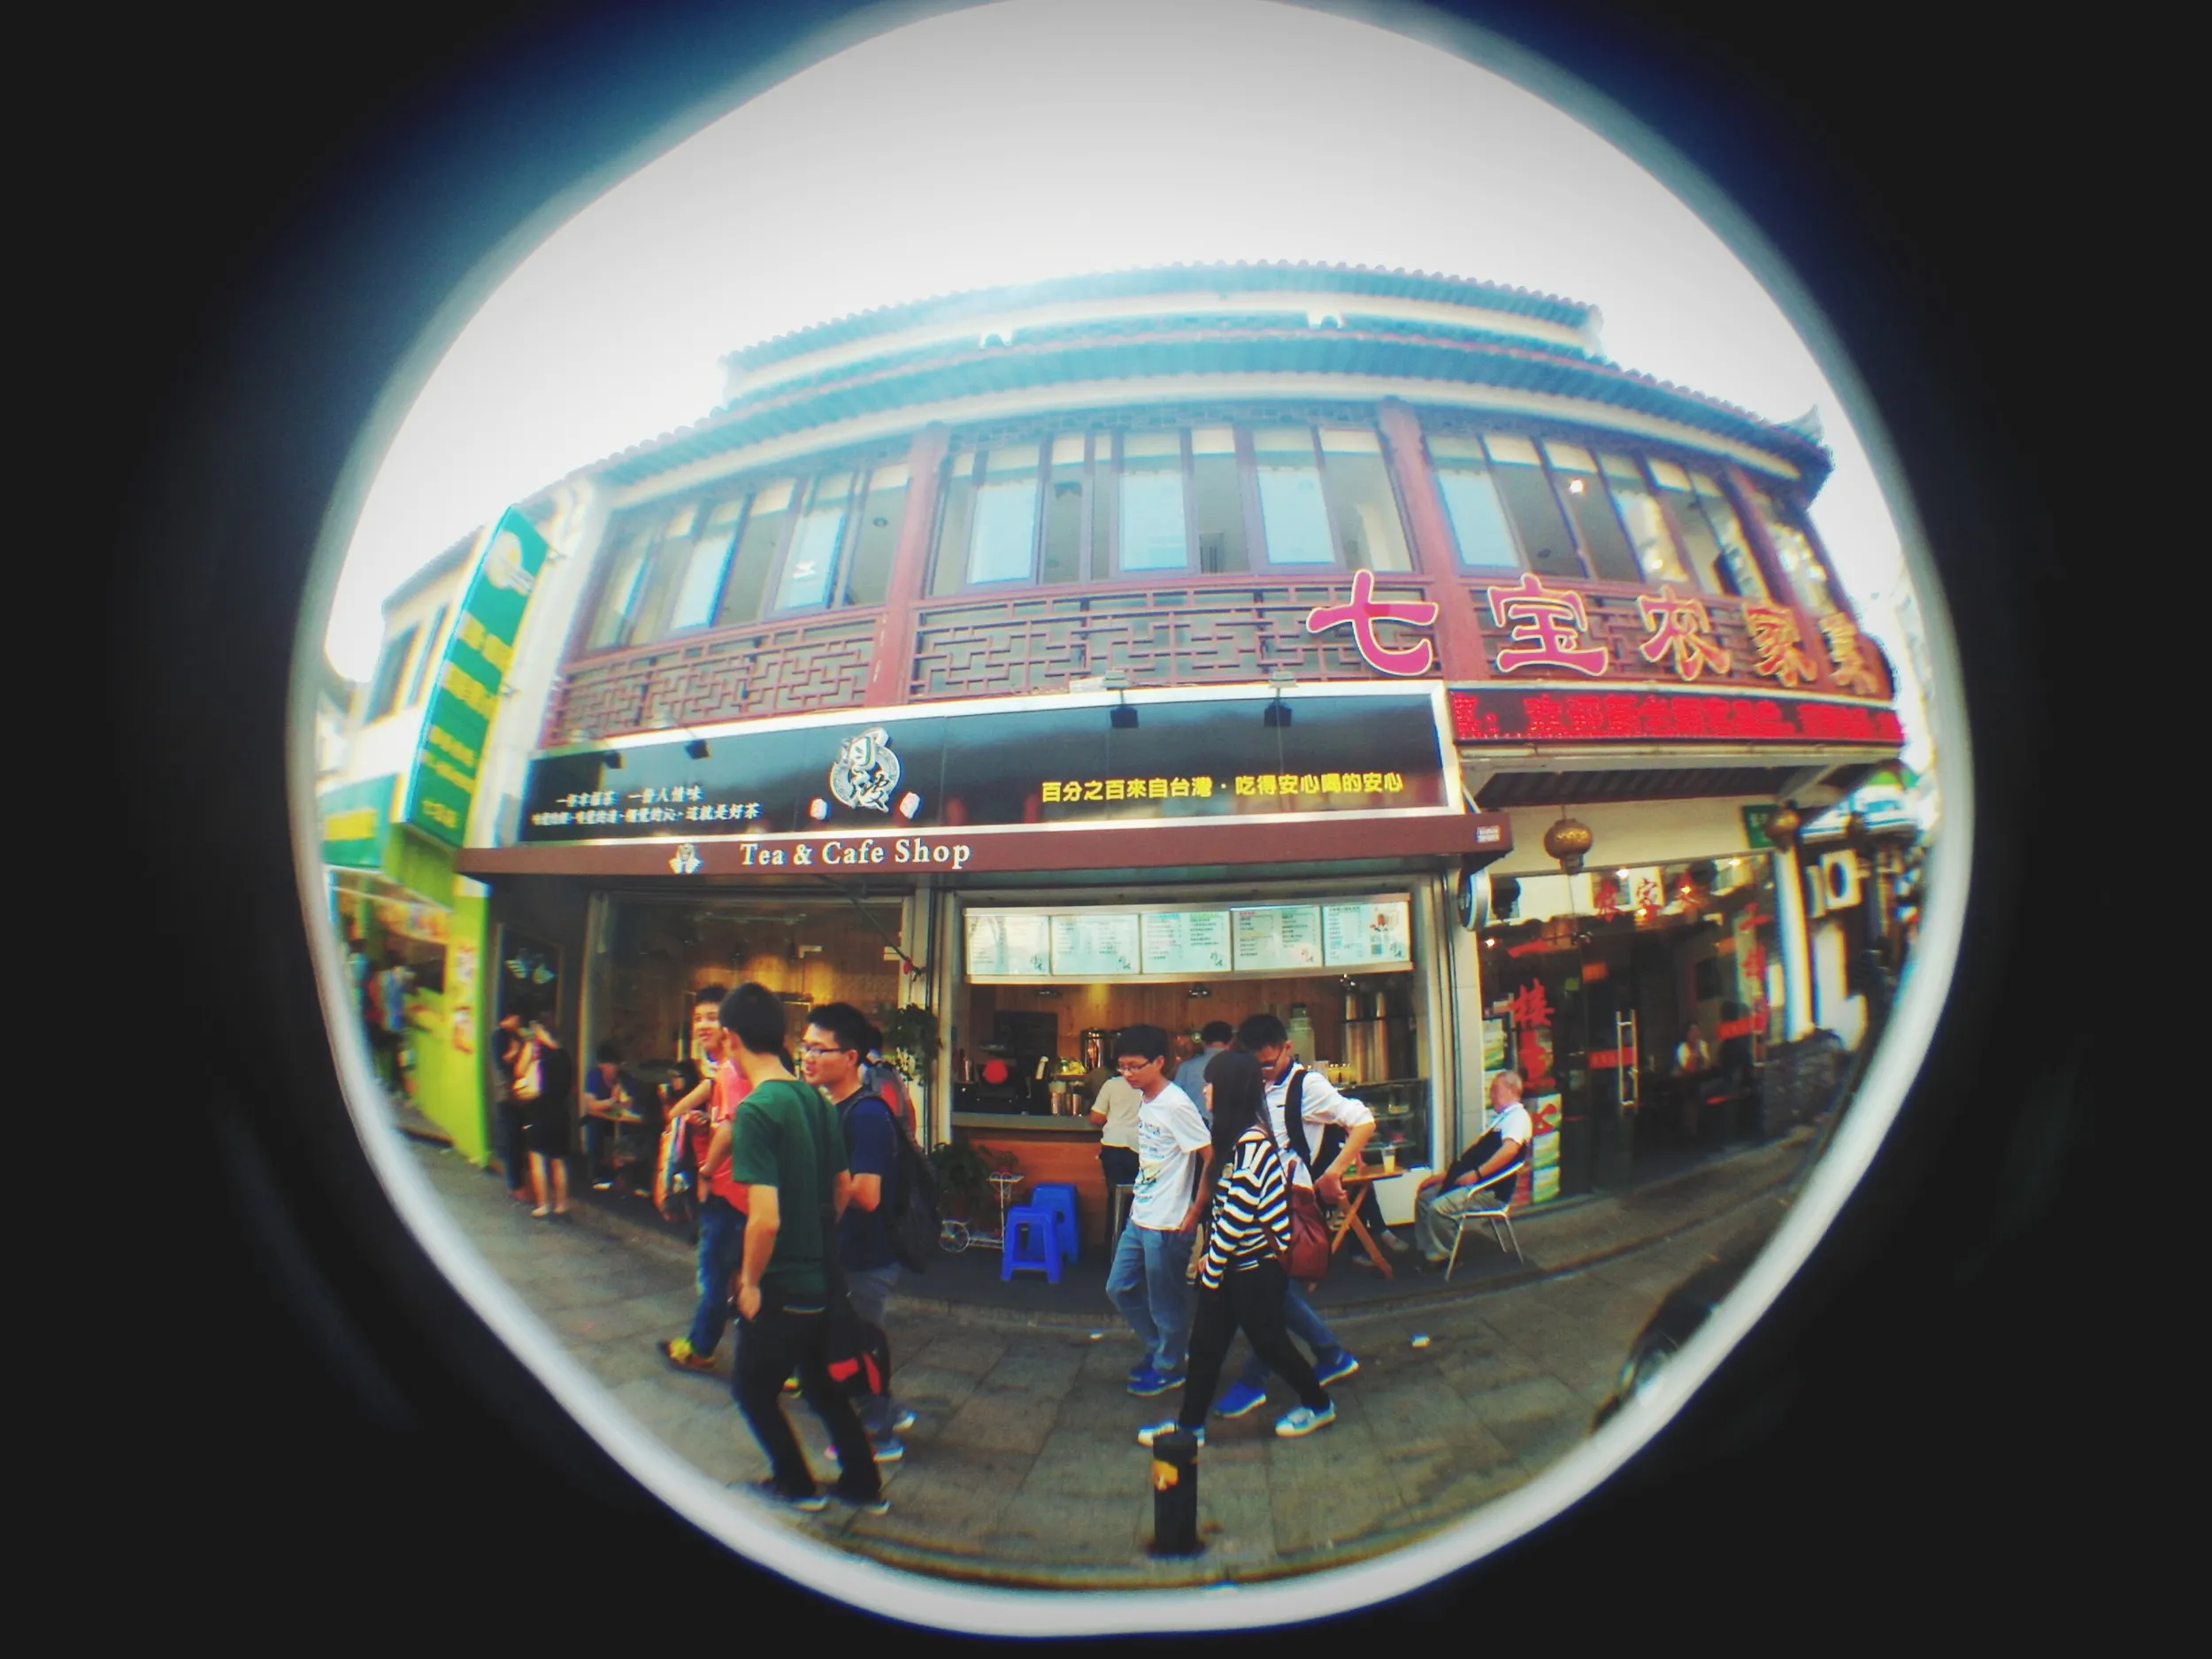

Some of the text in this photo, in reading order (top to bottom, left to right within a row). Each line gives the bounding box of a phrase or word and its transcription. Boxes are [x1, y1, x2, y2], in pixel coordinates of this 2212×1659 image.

[741, 838, 971, 869] Tea & Cafe Shop
